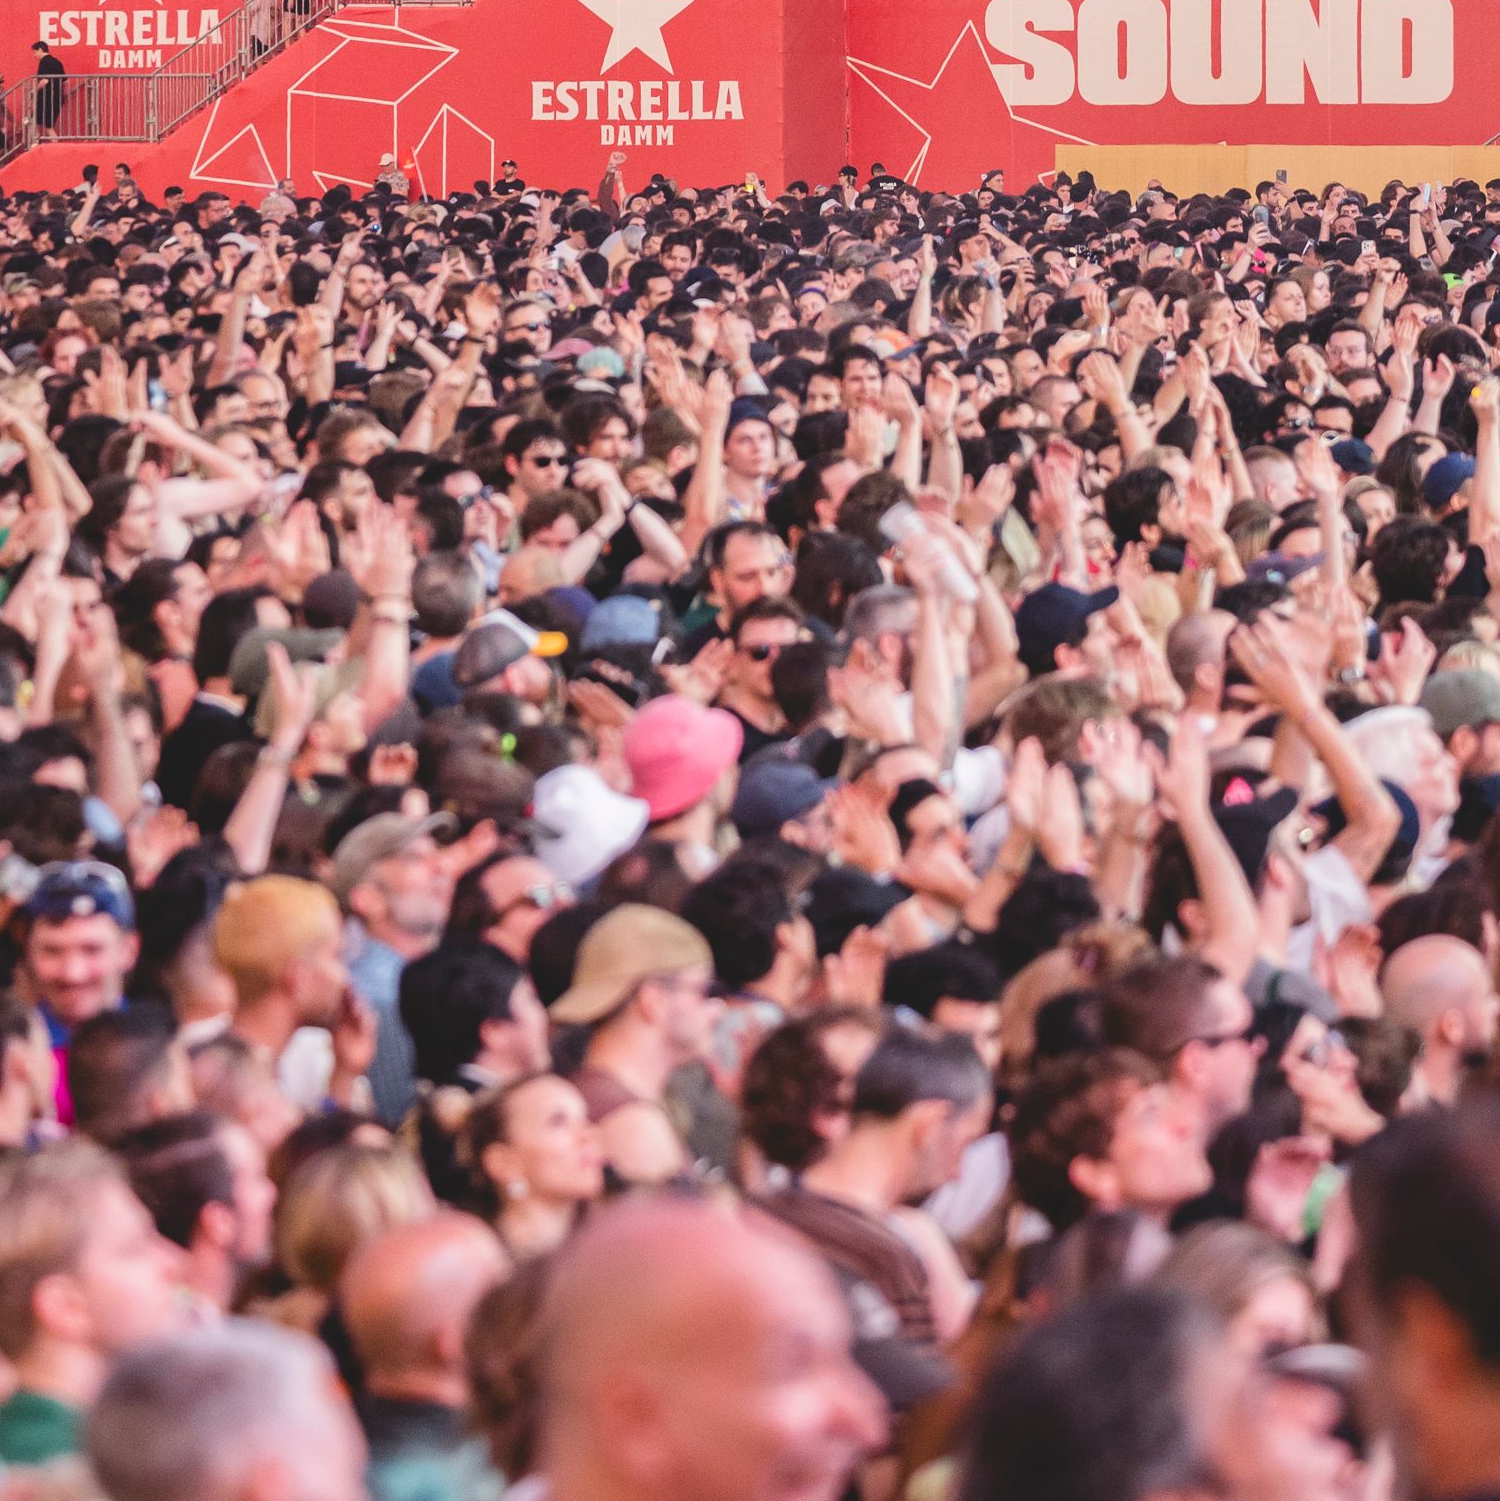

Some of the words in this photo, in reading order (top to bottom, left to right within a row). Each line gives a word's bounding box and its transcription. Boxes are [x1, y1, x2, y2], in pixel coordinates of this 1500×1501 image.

[39, 9, 222, 46] ESTRELLA
[98, 49, 163, 69] DAMM
[532, 80, 744, 121] ESTRELLA
[600, 124, 674, 146] DAMM
